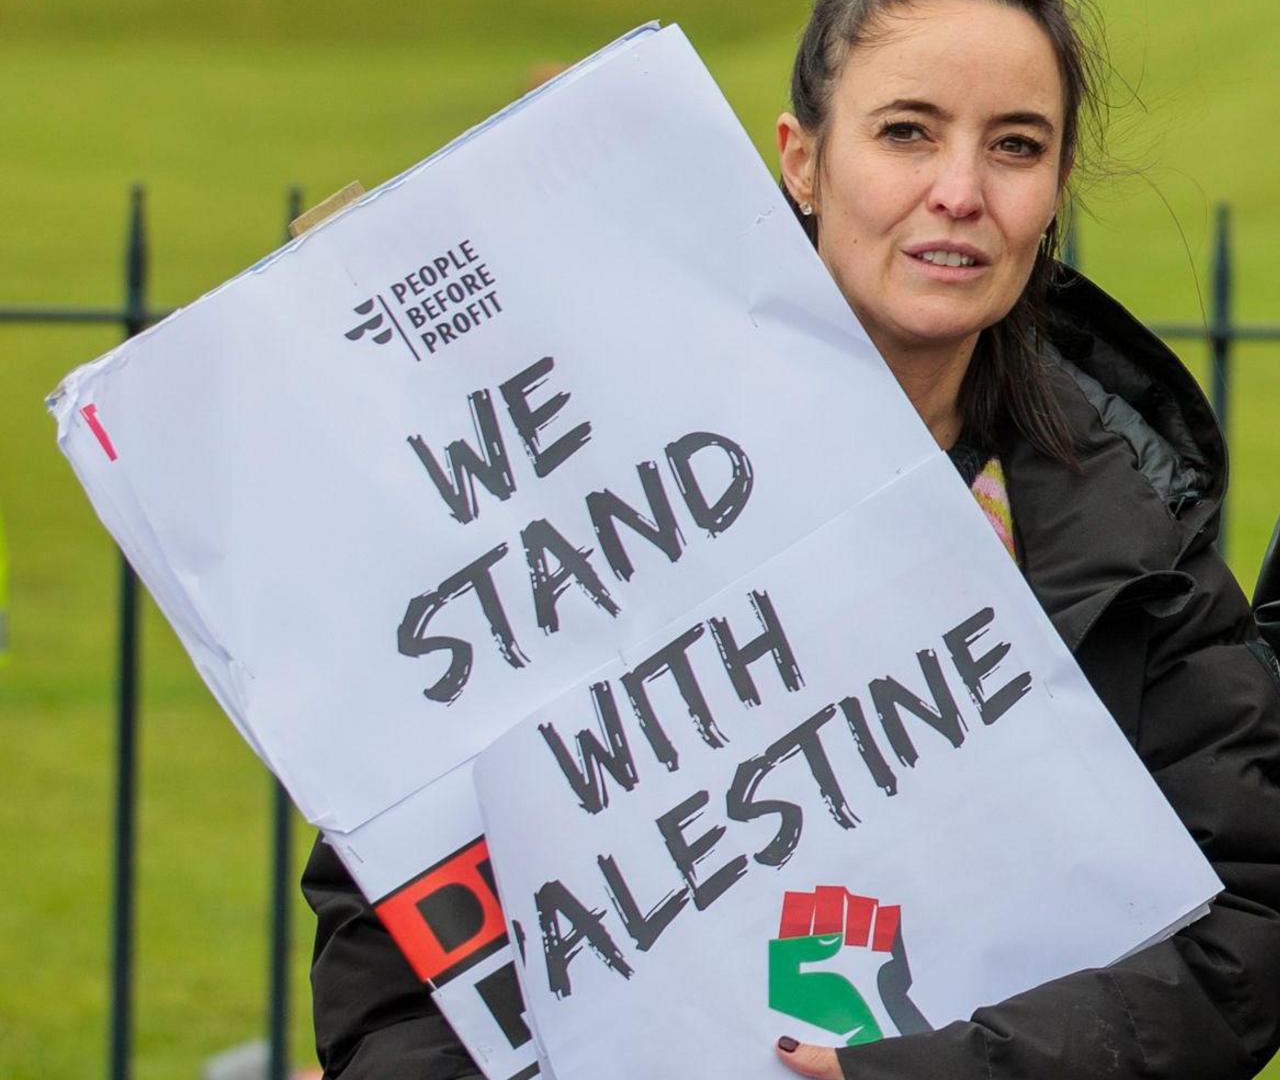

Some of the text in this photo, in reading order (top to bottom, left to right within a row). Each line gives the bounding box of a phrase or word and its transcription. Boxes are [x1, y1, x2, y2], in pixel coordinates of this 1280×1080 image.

[390, 240, 479, 305] PEOPLE
[405, 263, 496, 329] BEFORE
[420, 291, 503, 354] PROFIT
[406, 356, 592, 525] WE
[397, 431, 754, 708] STAND
[537, 589, 805, 815] WITH
[512, 606, 1032, 1000] ALESTINE
